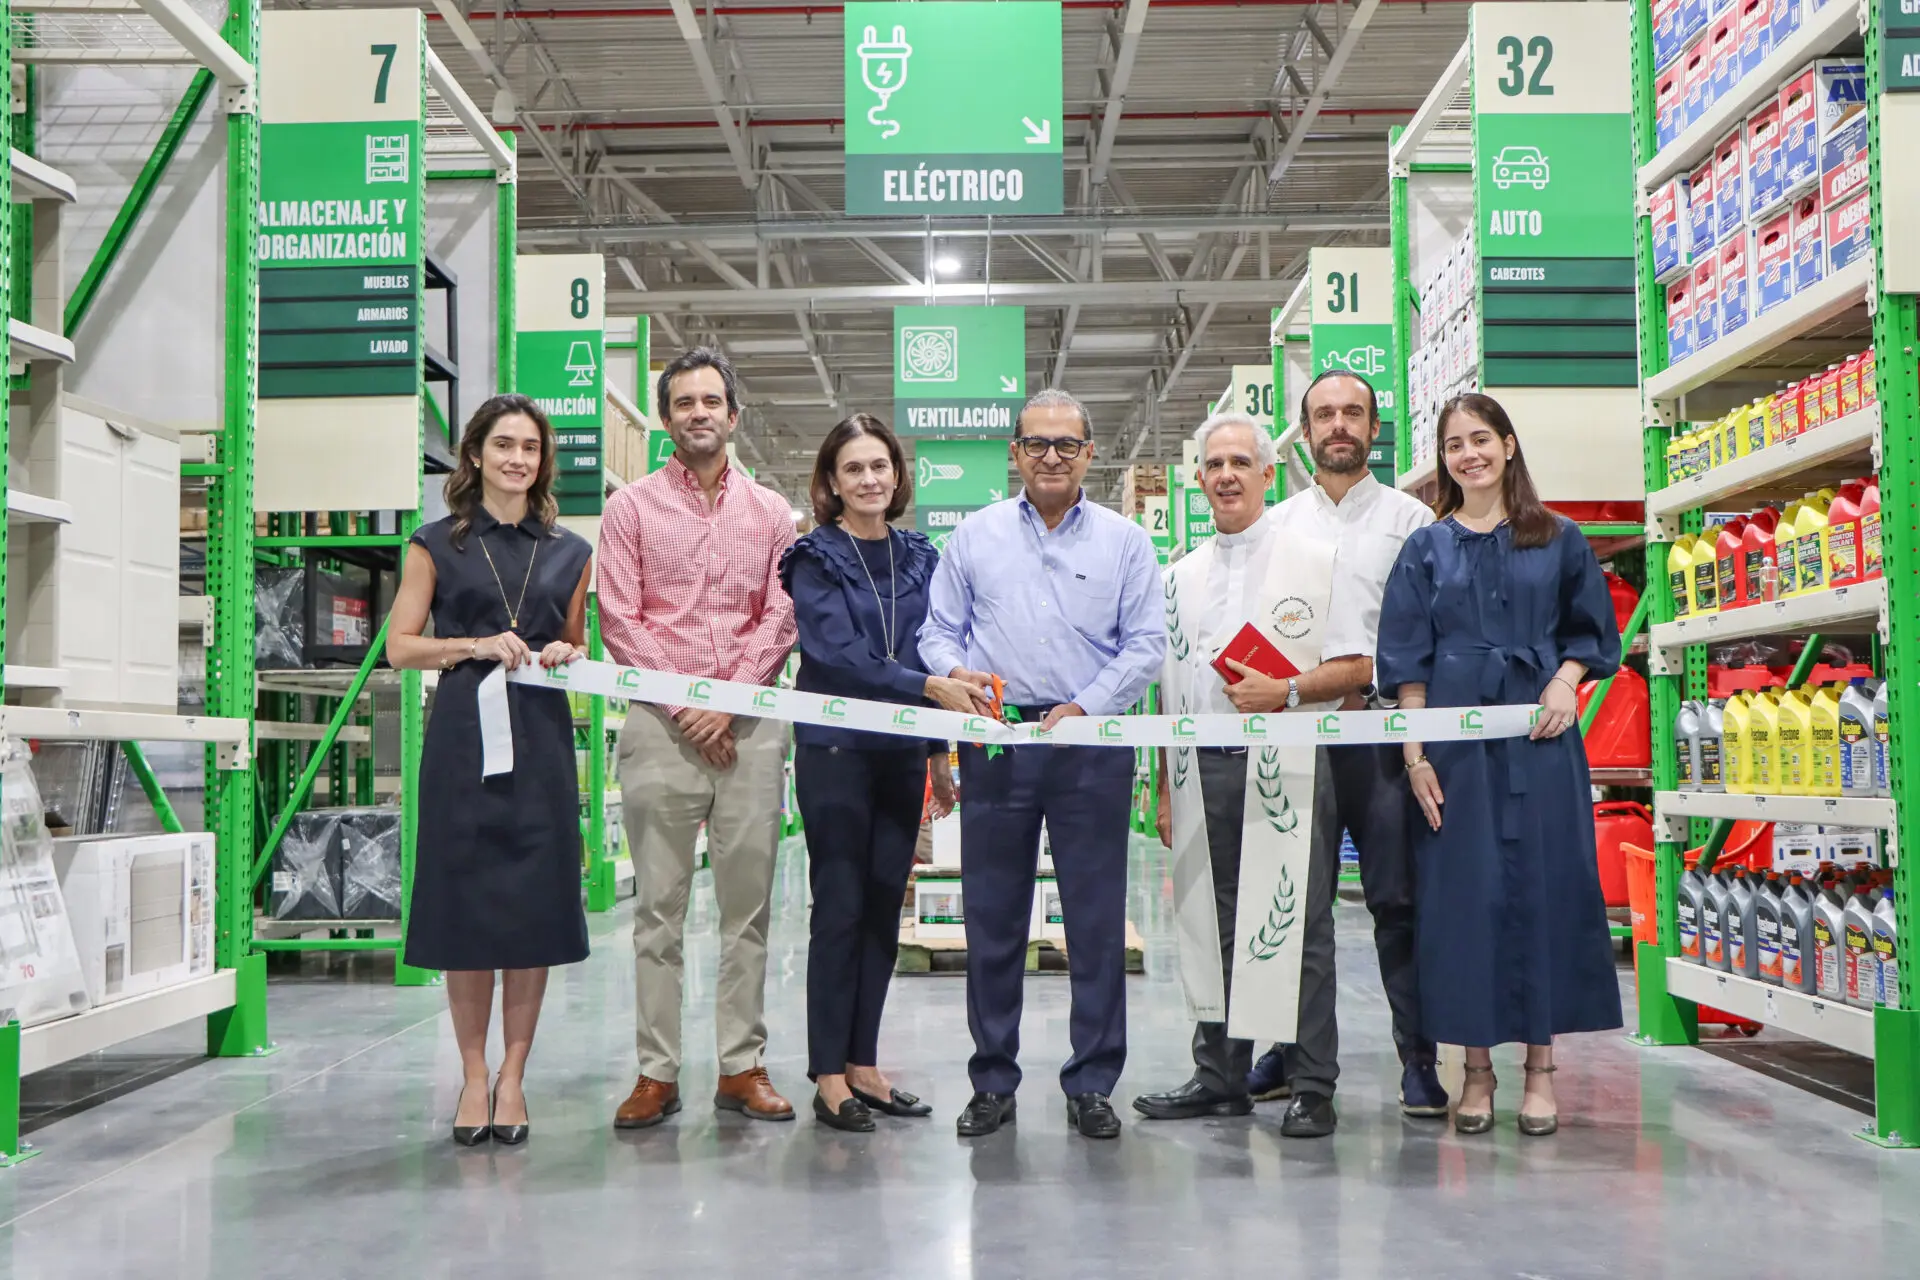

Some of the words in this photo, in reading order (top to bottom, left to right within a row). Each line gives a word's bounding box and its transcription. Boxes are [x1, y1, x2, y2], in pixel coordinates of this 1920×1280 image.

[370, 44, 398, 104] 7
[1497, 35, 1555, 96] 32
[1782, 92, 1812, 126] ABRO
[1750, 121, 1779, 153] ABRO
[883, 162, 1024, 202] ELÉCTRICO
[259, 200, 388, 227] ALMACENAJE
[393, 199, 407, 224] Y
[1490, 210, 1542, 237] AUTO
[258, 226, 406, 260] ORGANIZACIÓN
[1759, 234, 1788, 262] ABRO
[363, 276, 409, 289] MUEBLES
[1490, 267, 1545, 282] CABEZOTES
[571, 278, 589, 319] 8
[1327, 272, 1358, 313] 31
[357, 307, 408, 321] ARMARIOS
[370, 340, 408, 353] LAVADO
[907, 403, 1010, 428] VENTILACIÓN
[1245, 383, 1273, 416] 30
